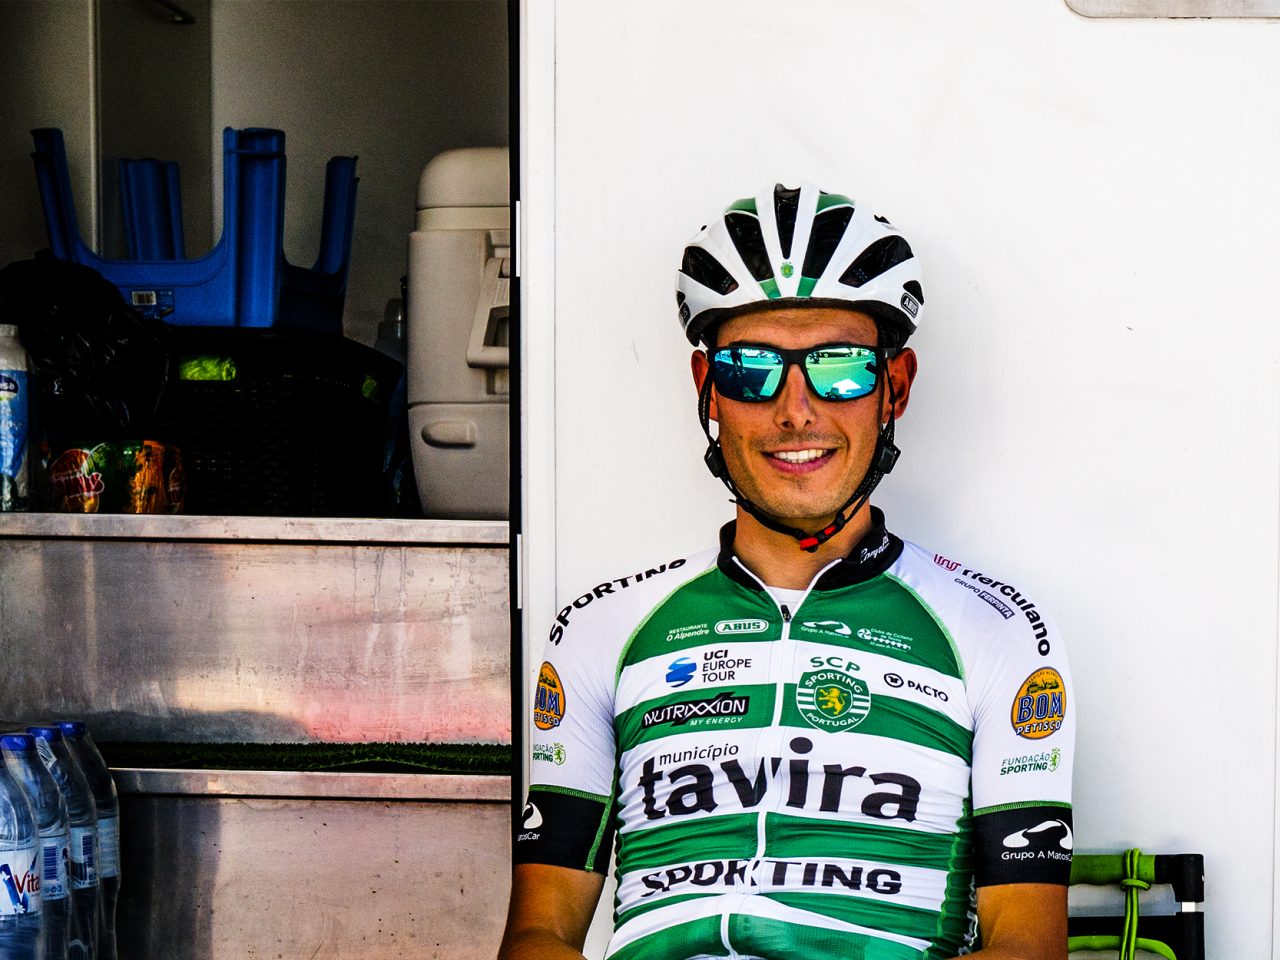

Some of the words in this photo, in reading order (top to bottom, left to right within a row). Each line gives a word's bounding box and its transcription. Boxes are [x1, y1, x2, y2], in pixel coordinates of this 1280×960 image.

[954, 577, 981, 594] GRUPO
[980, 592, 1012, 618] FERPINTA
[668, 623, 708, 635] RESTAURANTE
[721, 621, 761, 631] ABUS
[666, 634, 674, 642] O
[675, 628, 709, 640] Alpendre
[703, 649, 729, 661] UCI
[702, 658, 752, 672] EUROPE
[810, 656, 861, 672] SCP
[702, 670, 736, 682] TOUR
[805, 673, 863, 694] SPORTING
[907, 680, 949, 702] PACTO
[534, 684, 560, 716] OM
[1016, 691, 1063, 725] BOM
[643, 692, 749, 727] NUTRIXXION
[705, 716, 743, 725] ENERGY
[806, 712, 860, 727] PORTUGAL
[1016, 720, 1063, 735] PETISCO
[659, 743, 739, 766] município
[1001, 751, 1050, 767] FUNDAÇÃO
[1000, 762, 1049, 776] SPORTING
[638, 736, 922, 823] tavira
[1001, 851, 1035, 861] Grupo
[1037, 850, 1046, 859] A
[640, 859, 903, 898] SPORTING
